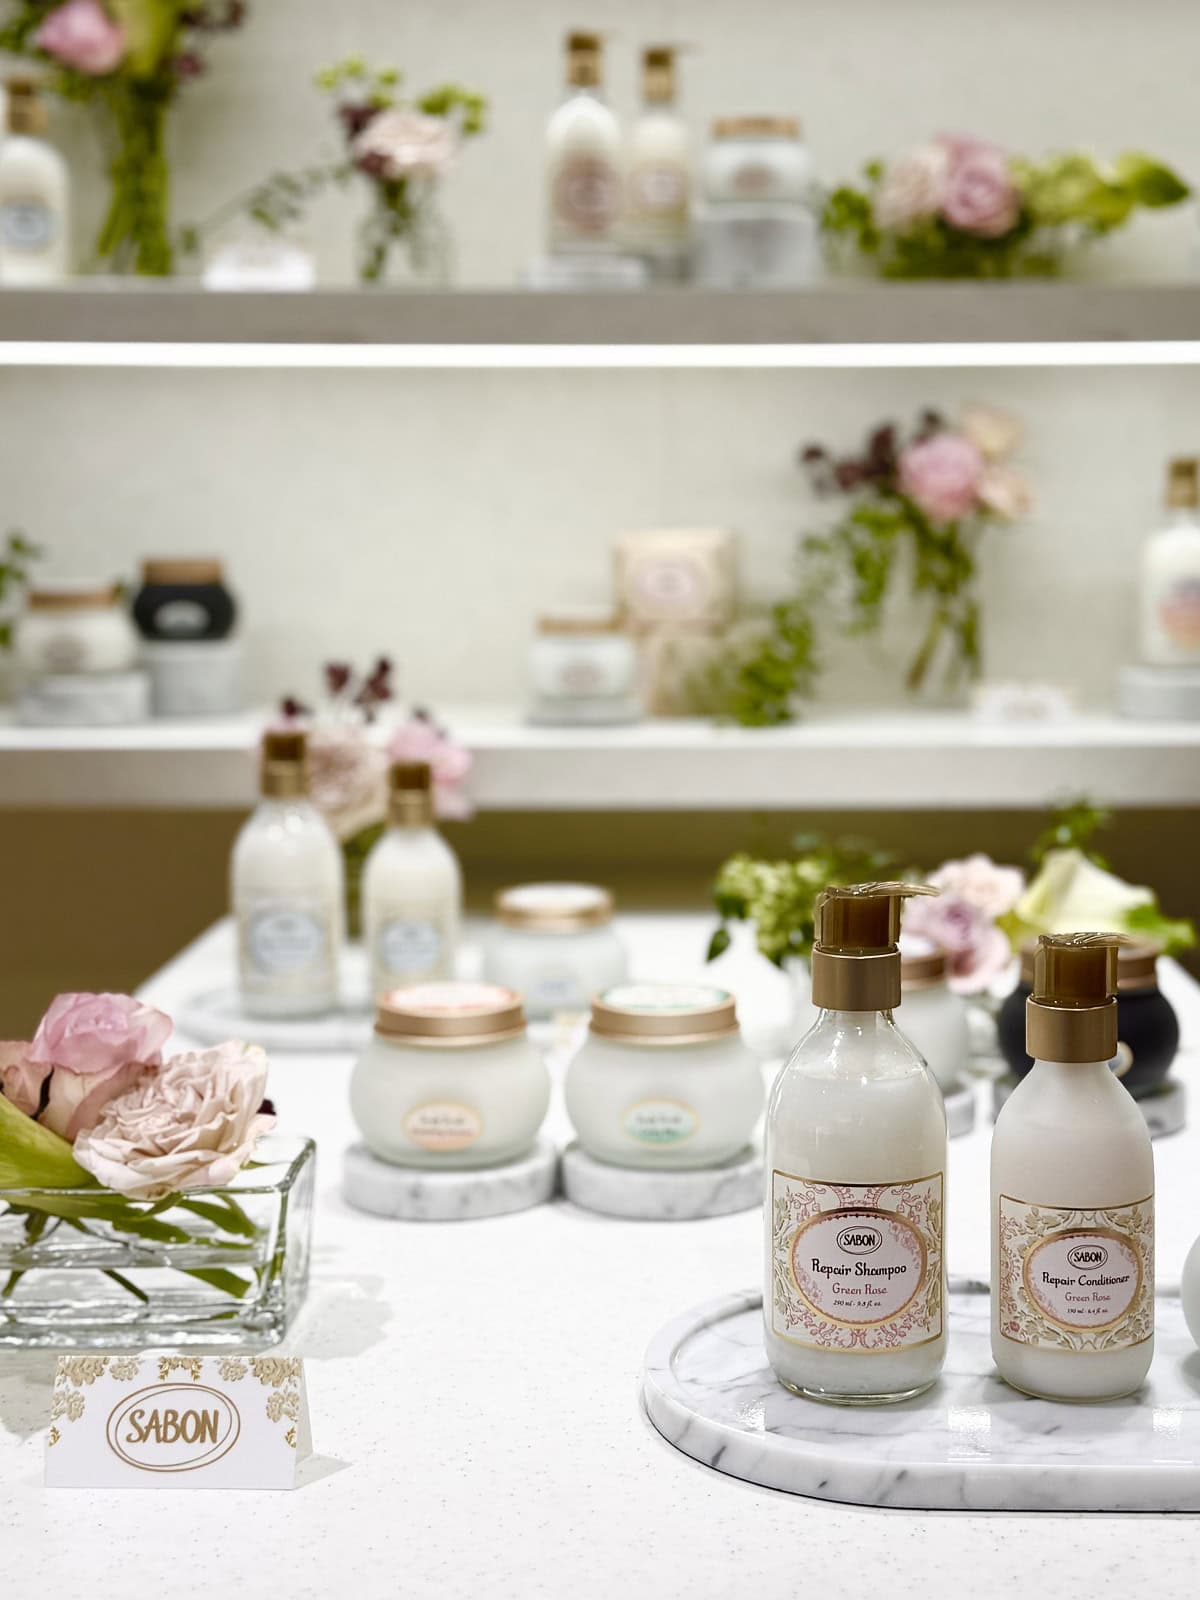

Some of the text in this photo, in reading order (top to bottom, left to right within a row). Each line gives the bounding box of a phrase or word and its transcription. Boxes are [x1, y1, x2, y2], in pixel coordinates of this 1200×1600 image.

[843, 1234, 876, 1246] SABON
[1074, 1252, 1102, 1262] SABON
[812, 1258, 907, 1280] Repair Shampoo
[1042, 1272, 1130, 1288] Repair Conditioner
[832, 1283, 888, 1295] Green Rose
[1065, 1292, 1111, 1302] Green Rose
[126, 1409, 219, 1444] SABON
